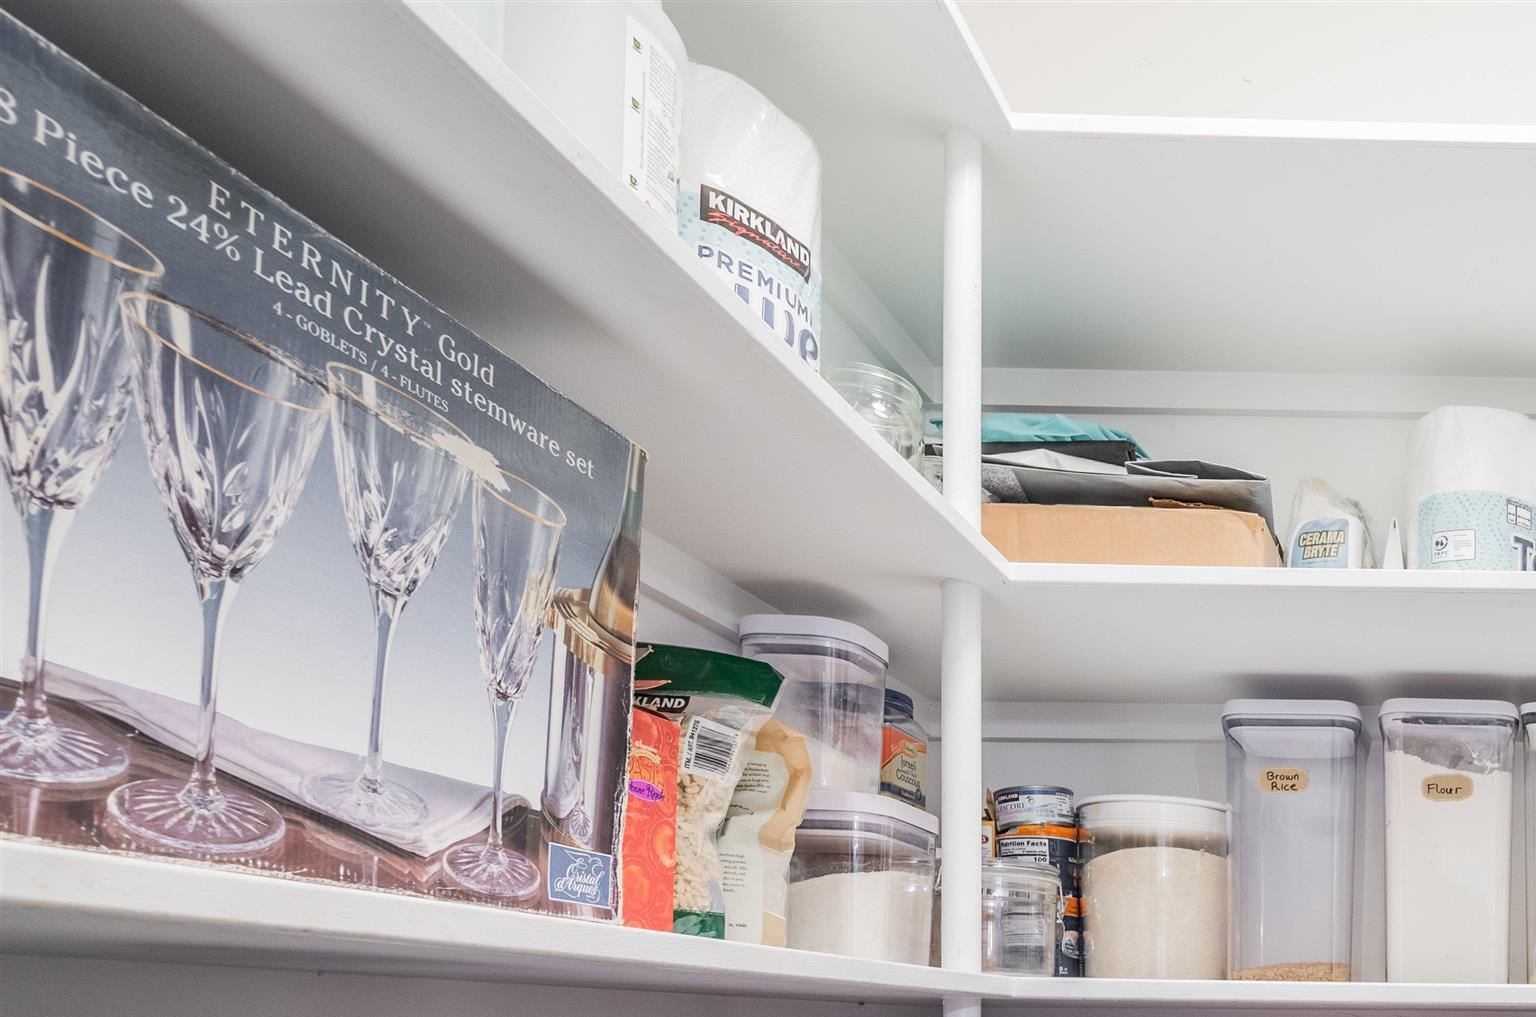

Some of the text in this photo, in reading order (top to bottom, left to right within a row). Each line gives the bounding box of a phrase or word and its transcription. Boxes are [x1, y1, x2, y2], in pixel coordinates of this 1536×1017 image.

[708, 190, 810, 268] KIRKLAND
[209, 180, 495, 388] ETERNITY Gold
[698, 244, 809, 323] PREMIUM
[34, 109, 595, 479] Piece 24% Lead Crystal stemware set
[1299, 530, 1345, 547] CERAMA
[1303, 544, 1339, 559] BRYTE
[1266, 771, 1300, 784] Brown
[1271, 782, 1297, 792] Rice
[1426, 783, 1463, 796] Flour
